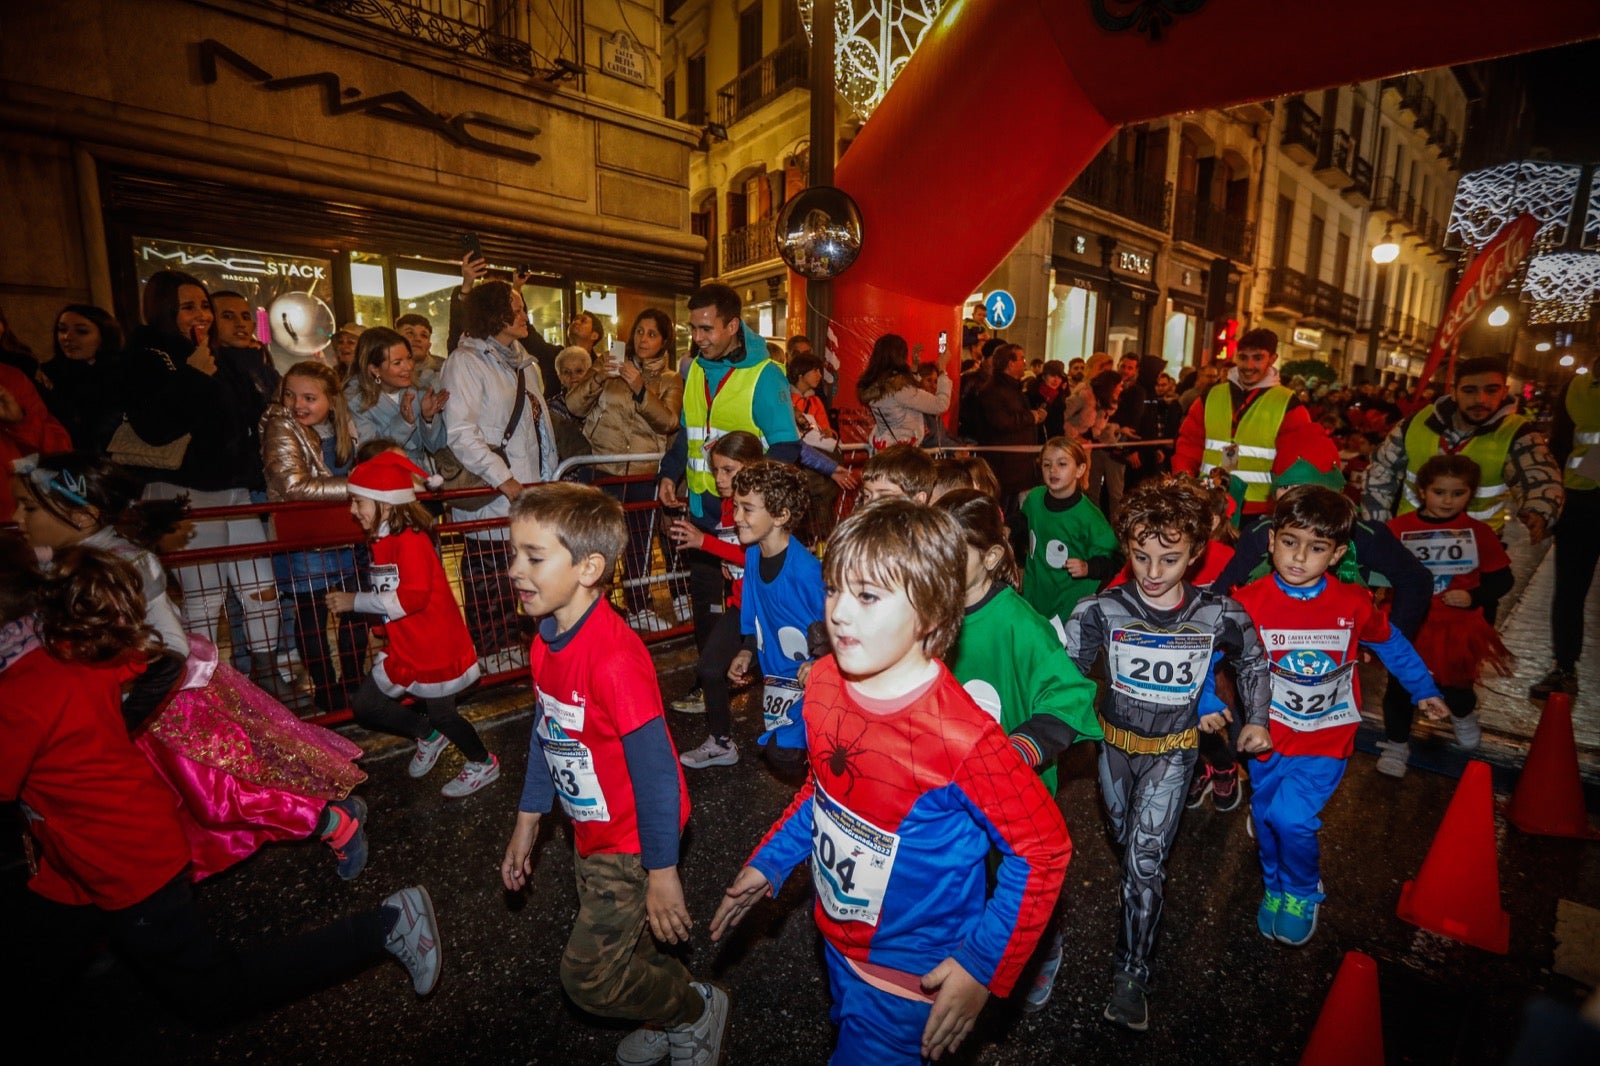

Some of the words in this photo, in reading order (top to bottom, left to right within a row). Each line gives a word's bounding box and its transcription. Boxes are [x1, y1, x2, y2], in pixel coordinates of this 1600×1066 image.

[221, 273, 260, 284] MASCARA
[1416, 544, 1462, 561] 370
[1271, 634, 1286, 646] 30
[1129, 657, 1194, 685] 203
[1284, 679, 1341, 715] 321
